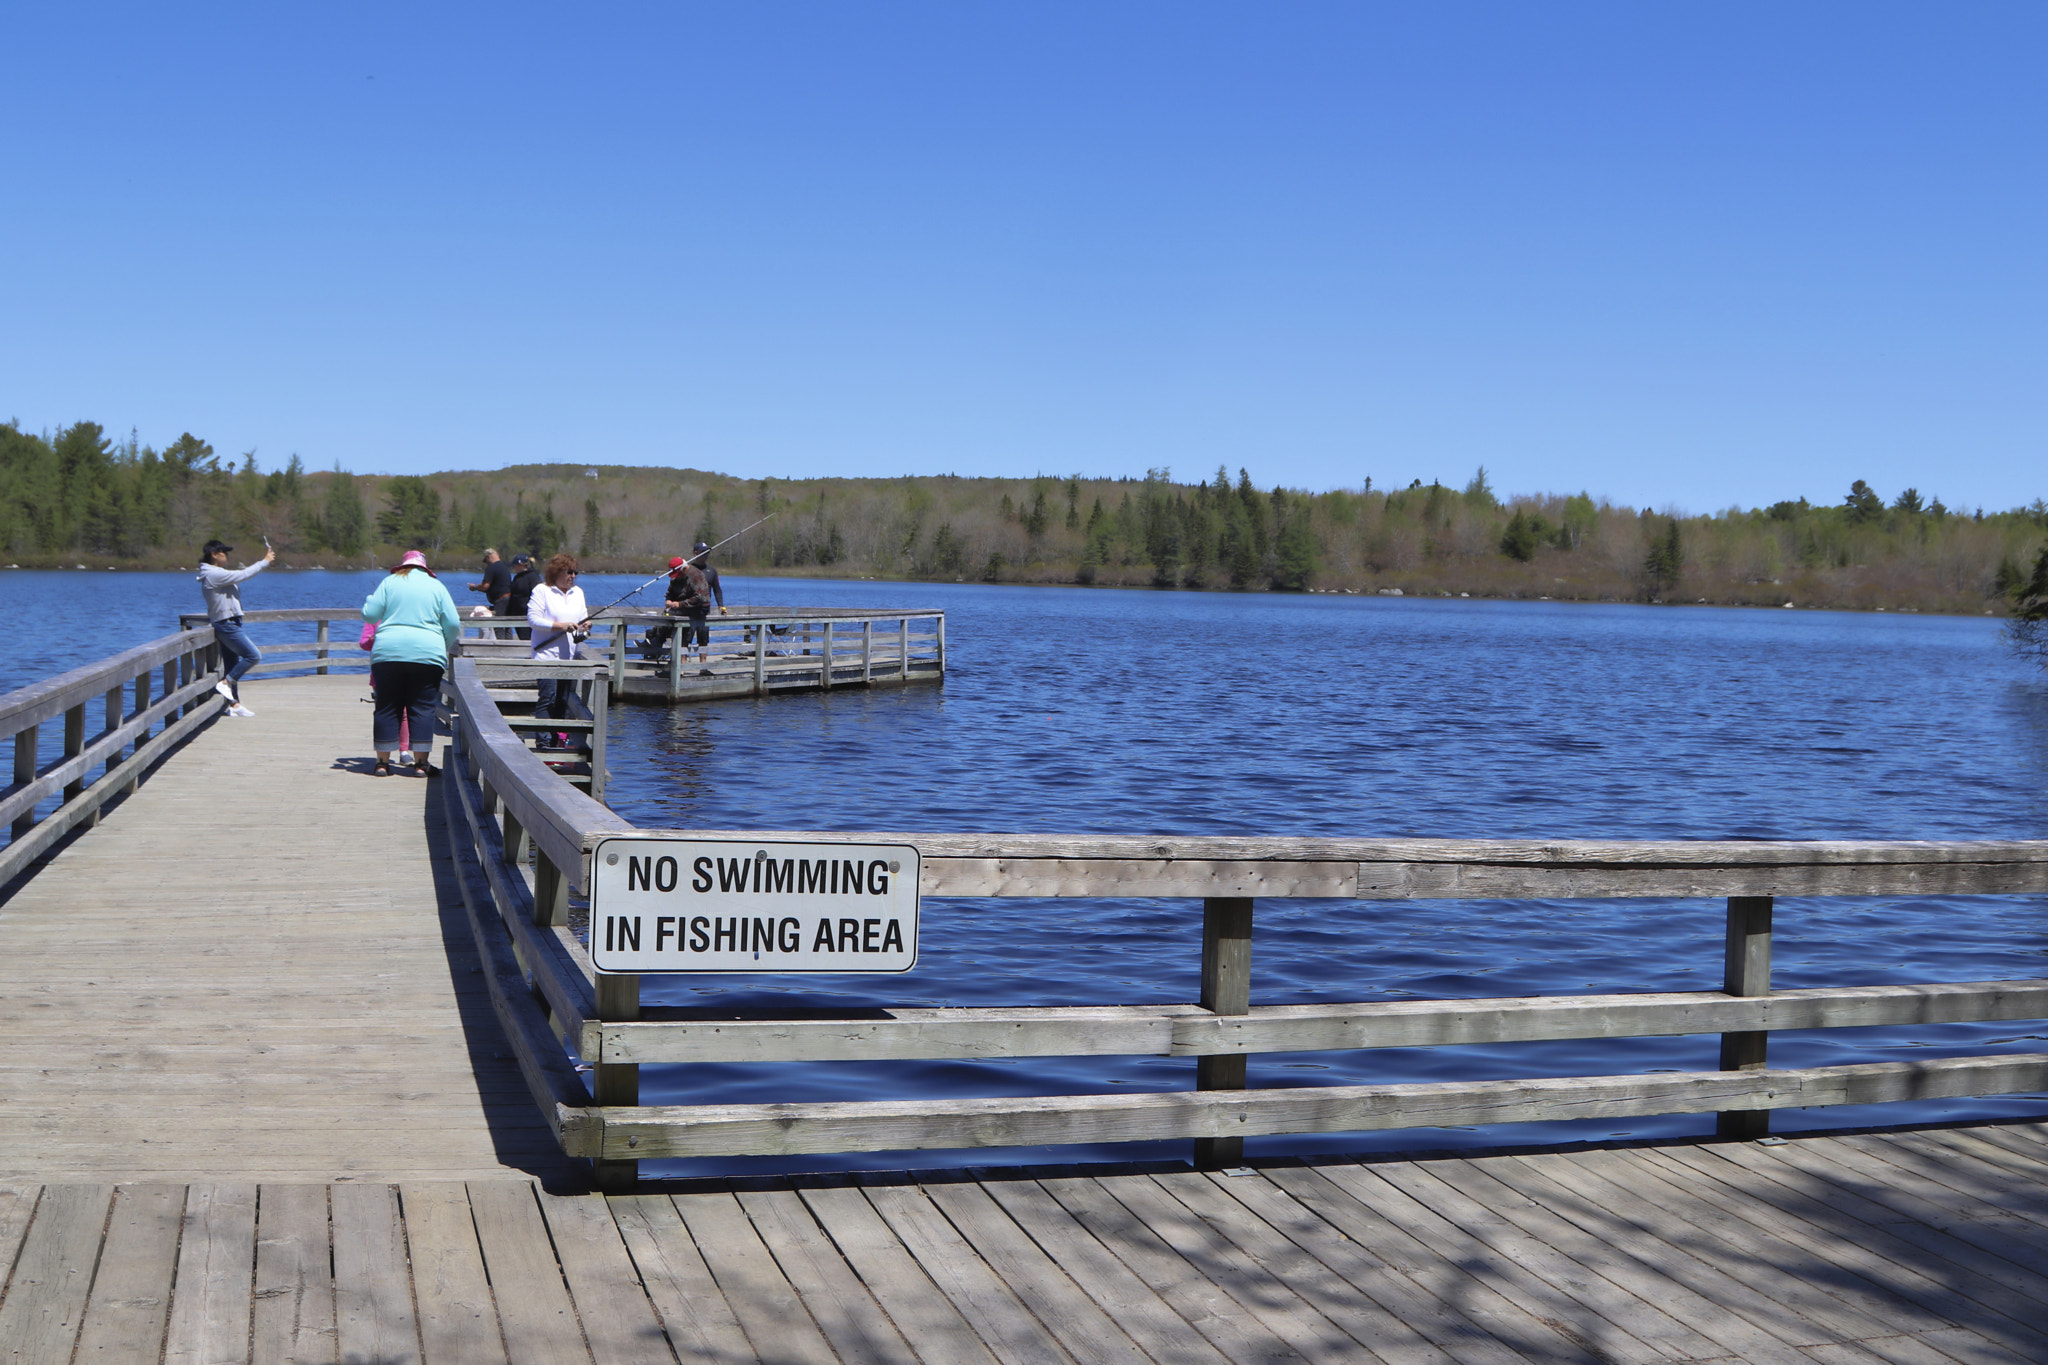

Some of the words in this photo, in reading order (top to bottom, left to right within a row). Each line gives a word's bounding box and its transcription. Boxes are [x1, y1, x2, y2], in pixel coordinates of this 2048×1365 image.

[628, 855, 678, 892] NO
[692, 856, 889, 895] SWIMMING
[605, 915, 641, 952] IN
[656, 916, 800, 953] FISHING
[813, 918, 904, 953] AREA
